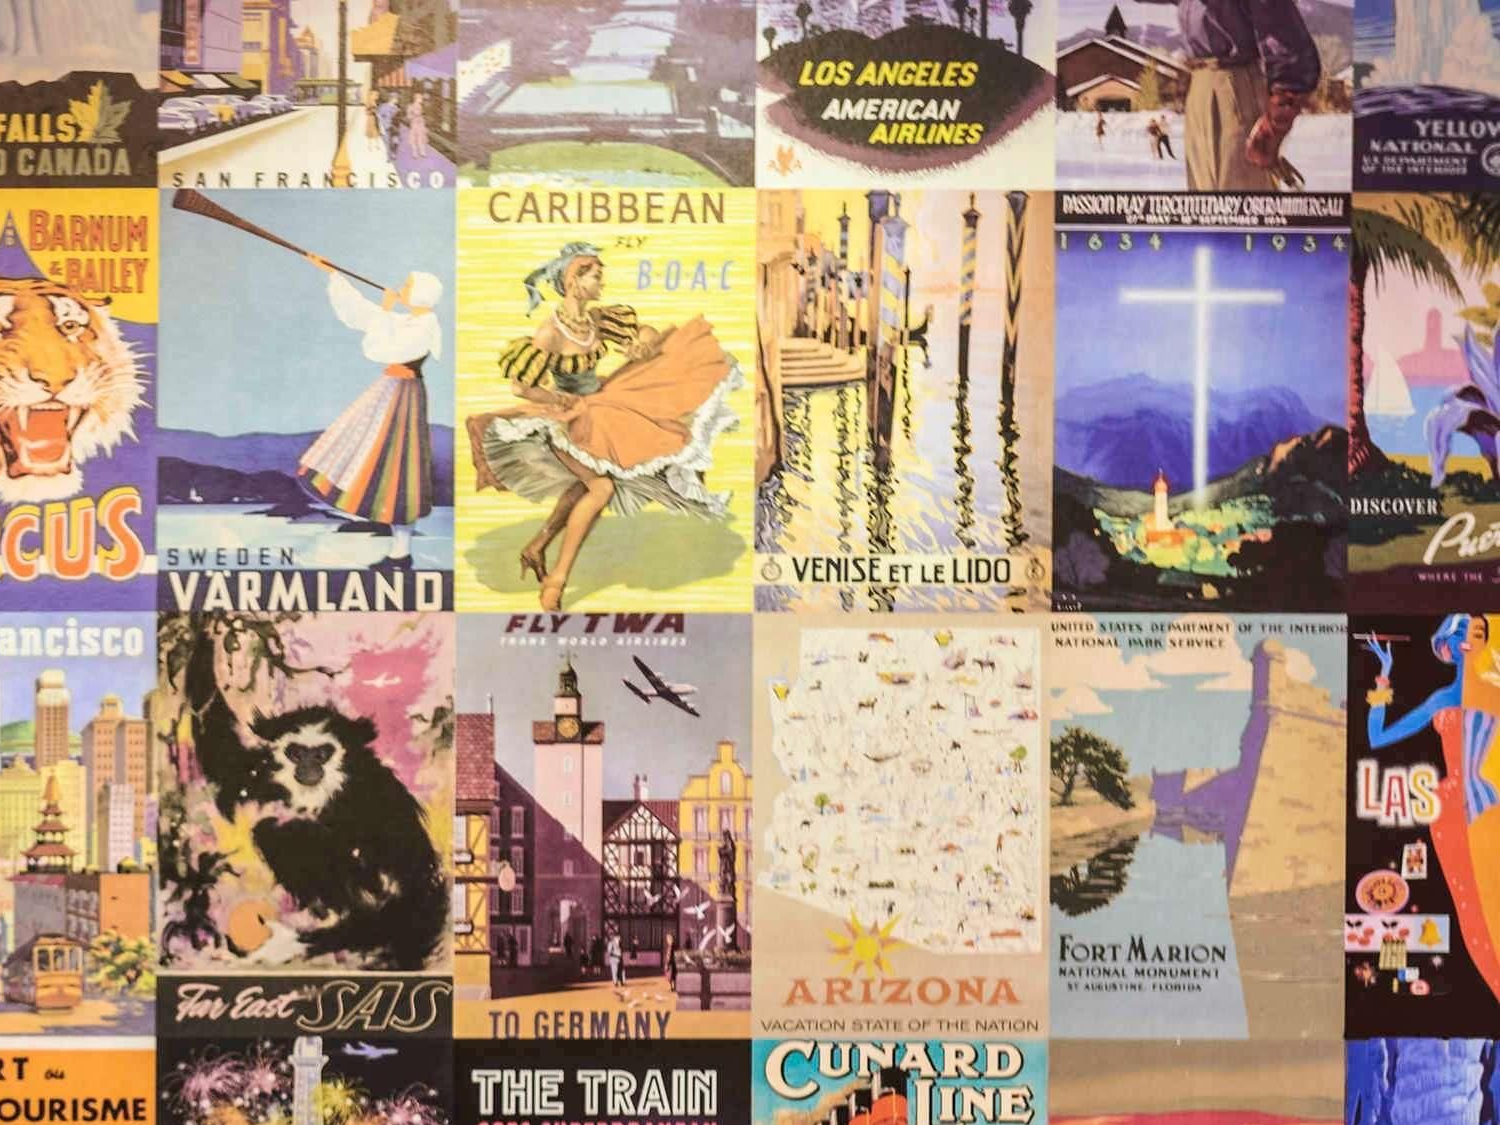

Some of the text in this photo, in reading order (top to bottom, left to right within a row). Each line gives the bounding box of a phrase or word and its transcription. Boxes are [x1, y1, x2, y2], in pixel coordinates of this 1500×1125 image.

[799, 60, 979, 88] LOS ANGELES
[821, 99, 961, 121] AMERICAN
[868, 122, 984, 146] AIRLINES
[1370, 139, 1477, 155] NATIONAL
[17, 148, 131, 176] CANADA
[172, 171, 446, 188] SAN FRANCISCO
[488, 191, 727, 225] CARIBBEAN
[28, 208, 150, 252] BARNUM
[65, 257, 150, 294] BAILEY
[1350, 497, 1439, 516] DISCOVER
[166, 547, 296, 566] SWEDEN
[793, 556, 1012, 584] VENISE ET LE LIDO
[168, 568, 444, 612] VÄRMLAND
[505, 612, 686, 634] FLY TWA
[1150, 622, 1232, 633] DEPARTMENT
[616, 636, 688, 648] AIRLINES
[1055, 637, 1120, 649] NATIONAL
[1356, 758, 1441, 828] LAS
[1058, 934, 1227, 964] FORT MARION
[1058, 967, 1220, 979] NATIONAL MONUMENT
[176, 982, 230, 1022] Far
[231, 985, 296, 1020] East
[296, 979, 453, 1032] SAS
[789, 976, 1021, 1008] ARIZONA
[488, 1010, 673, 1039] TO GERMANY
[761, 1018, 1041, 1034] VACATION STATE OF THE NATION
[764, 1040, 1025, 1100] CUNARD
[470, 1068, 719, 1117] THE TRAIN
